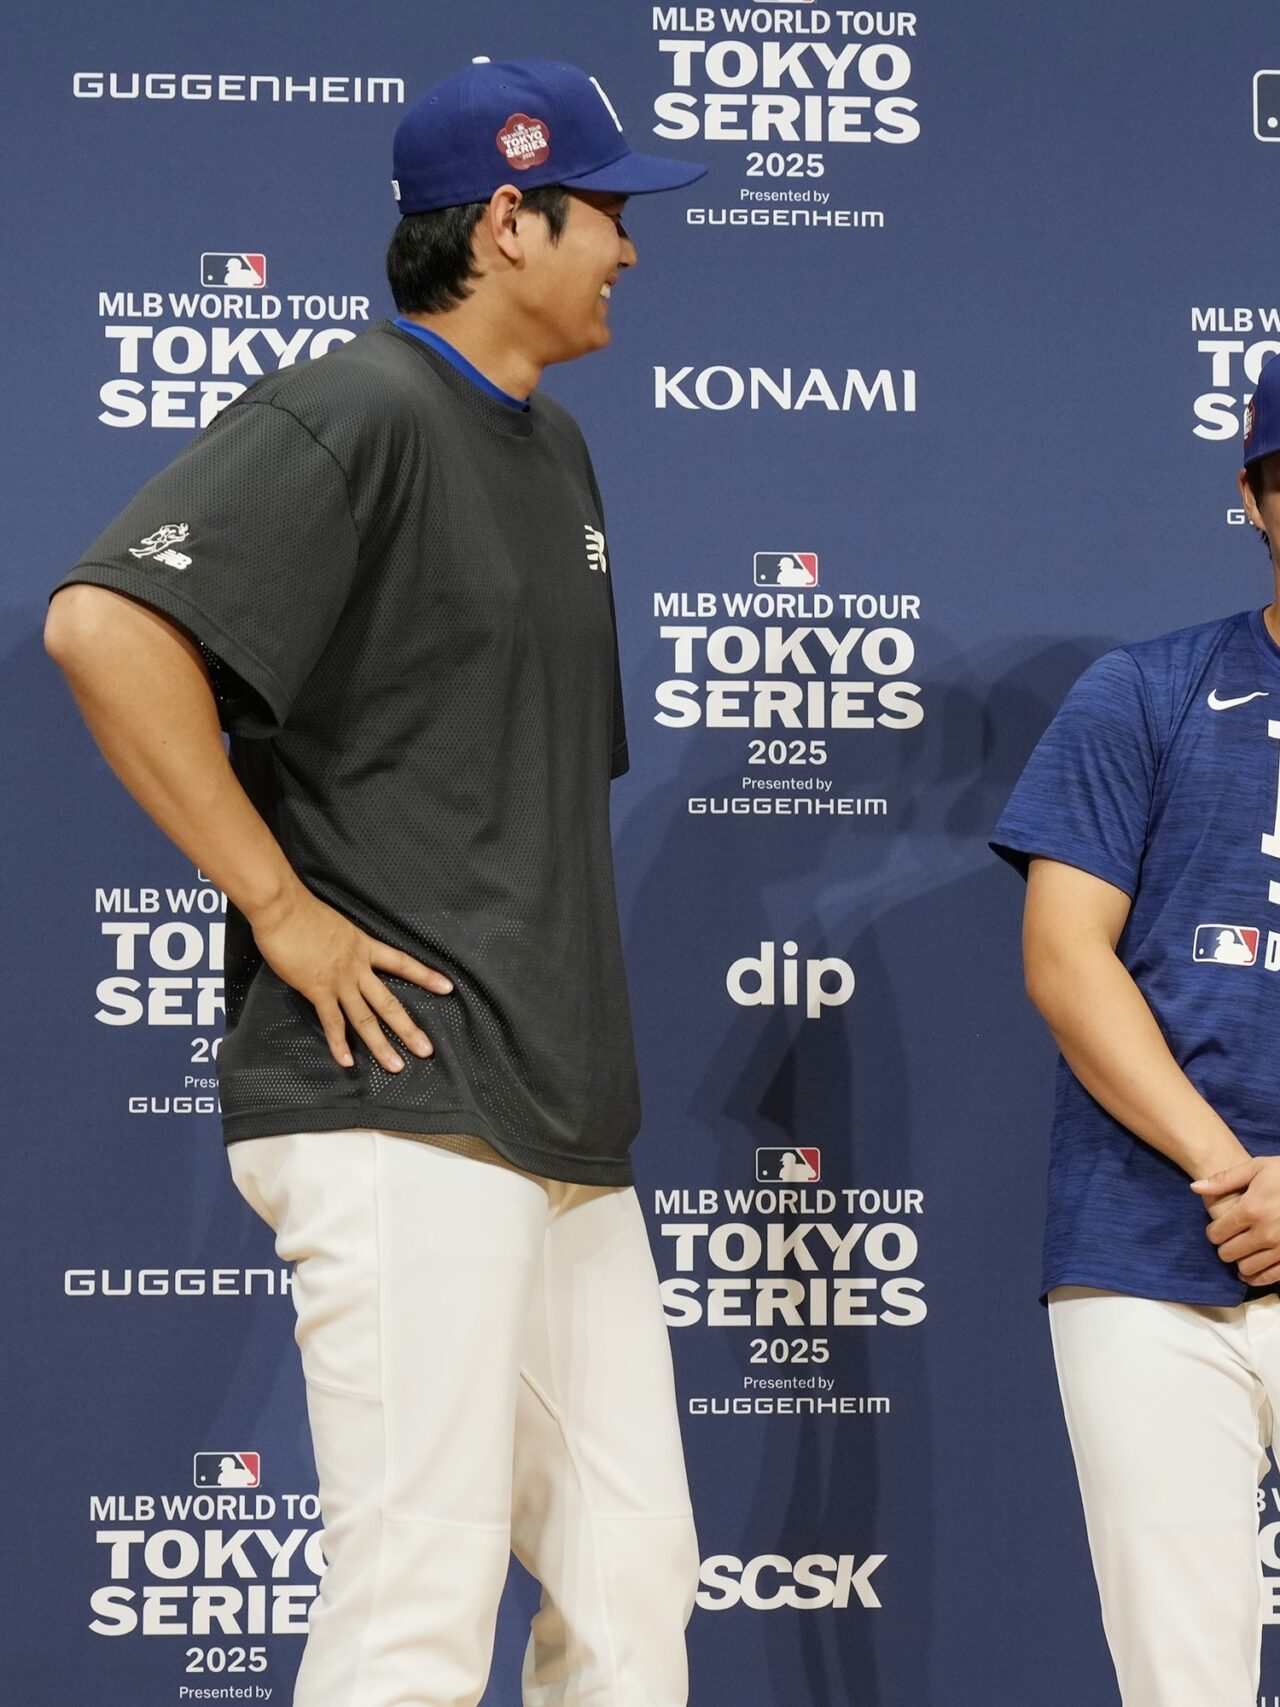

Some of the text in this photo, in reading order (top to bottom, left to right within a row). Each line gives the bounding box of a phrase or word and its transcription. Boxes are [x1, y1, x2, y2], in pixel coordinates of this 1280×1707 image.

[652, 6, 917, 37] MLB WORLD TOUR
[658, 39, 912, 91] TOKYO
[73, 72, 405, 104] GUGGENHEIM
[652, 92, 921, 144] SERIES
[503, 130, 543, 148] TOKYO
[506, 138, 548, 158] SERIES
[746, 152, 825, 178] 2025
[740, 188, 830, 205] Presented by
[686, 208, 884, 228] GUGGENHEIM
[98, 291, 370, 321] MLB WORLD TOUR
[1191, 307, 1254, 332] MLB
[653, 365, 916, 412] KONAMI
[653, 592, 921, 619] MLB WORLD TOUR
[659, 625, 915, 676] TOKYO
[653, 679, 924, 730] SERIES
[748, 739, 828, 765] 2025
[742, 777, 833, 792] Presented by
[688, 797, 887, 815] GUGGENHEIM
[95, 888, 160, 913] MLB
[726, 940, 856, 1019] dip
[654, 1189, 924, 1215] MLB WORLD TOUR
[660, 1222, 918, 1272] TOKYO
[659, 1277, 928, 1329] SERIES
[749, 1338, 830, 1364] 2025
[743, 1376, 835, 1391] Presented by
[689, 1397, 890, 1415] GUGGENHEIM
[90, 1495, 155, 1521] MLB
[160, 1494, 276, 1521] WORLD
[695, 1553, 889, 1612] SCSK
[185, 1646, 268, 1673] 2025
[179, 1685, 273, 1701] Presented by
